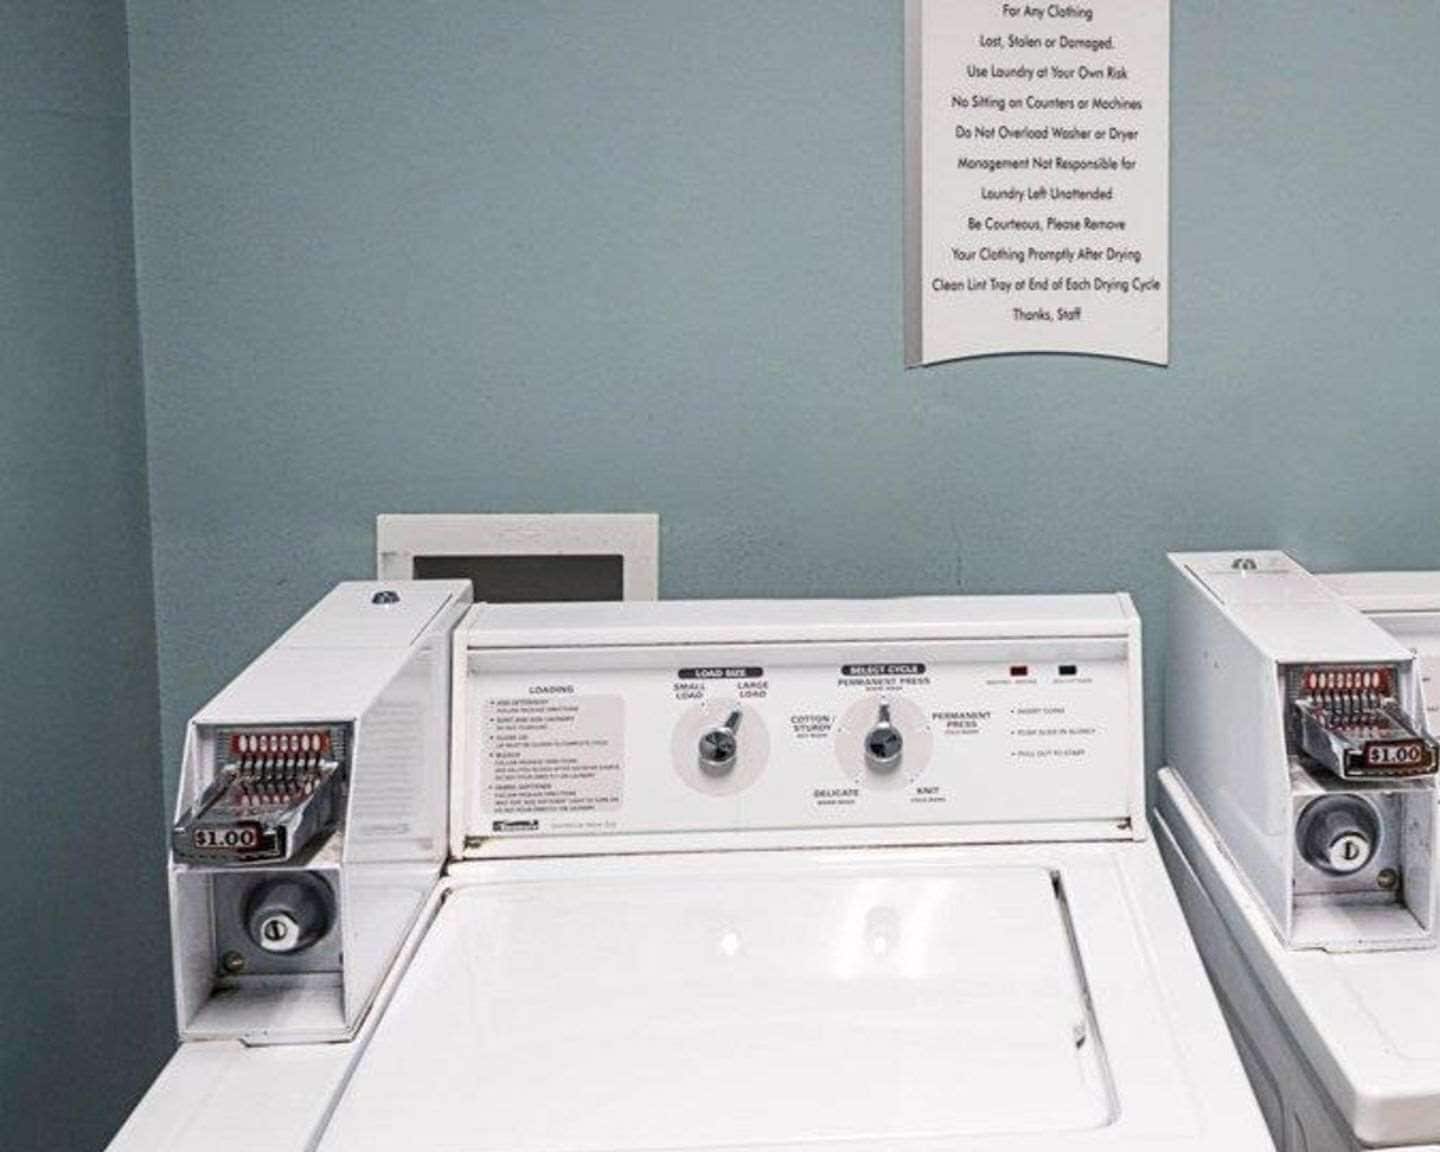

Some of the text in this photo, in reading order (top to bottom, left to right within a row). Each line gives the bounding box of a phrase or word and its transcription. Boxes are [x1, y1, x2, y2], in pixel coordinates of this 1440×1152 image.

[1002, 4, 1093, 22] For Any Clothing
[979, 34, 1115, 52] Lost, Stolen or Damaged.
[966, 64, 1128, 81] Use Laundry at Your Own Risk
[951, 94, 1142, 112] No Sitting on Counters or Machines
[955, 125, 1138, 143] Do Not Overload Washer or Dryer
[957, 156, 1136, 173] Management Not Responsible for
[981, 186, 1047, 203] Laundry Left
[968, 216, 1126, 232] Be Courteous, Please Remove
[951, 247, 1142, 264] Your Clothing Promptly After Drying
[932, 277, 1161, 293] Clean Lint Tray at End of Each Drying Cycle
[1012, 307, 1082, 322] Thanks, Staff
[695, 669, 746, 678] LOAD SIZE
[673, 682, 705, 691] SMALL
[737, 681, 769, 690] LARGE
[838, 677, 931, 687] PERMANENT PRESS
[529, 685, 574, 694] LOADING
[676, 691, 703, 700] LOAD
[740, 690, 767, 698] LOAD
[790, 715, 830, 724] COTTON
[932, 711, 991, 721] PERMANENT
[793, 724, 831, 732] STURDY
[946, 720, 978, 729] PRESS
[1369, 747, 1420, 762] $1.00
[813, 789, 859, 798] DELICATE
[916, 786, 939, 795] KNIT
[195, 831, 254, 846] $1.00
